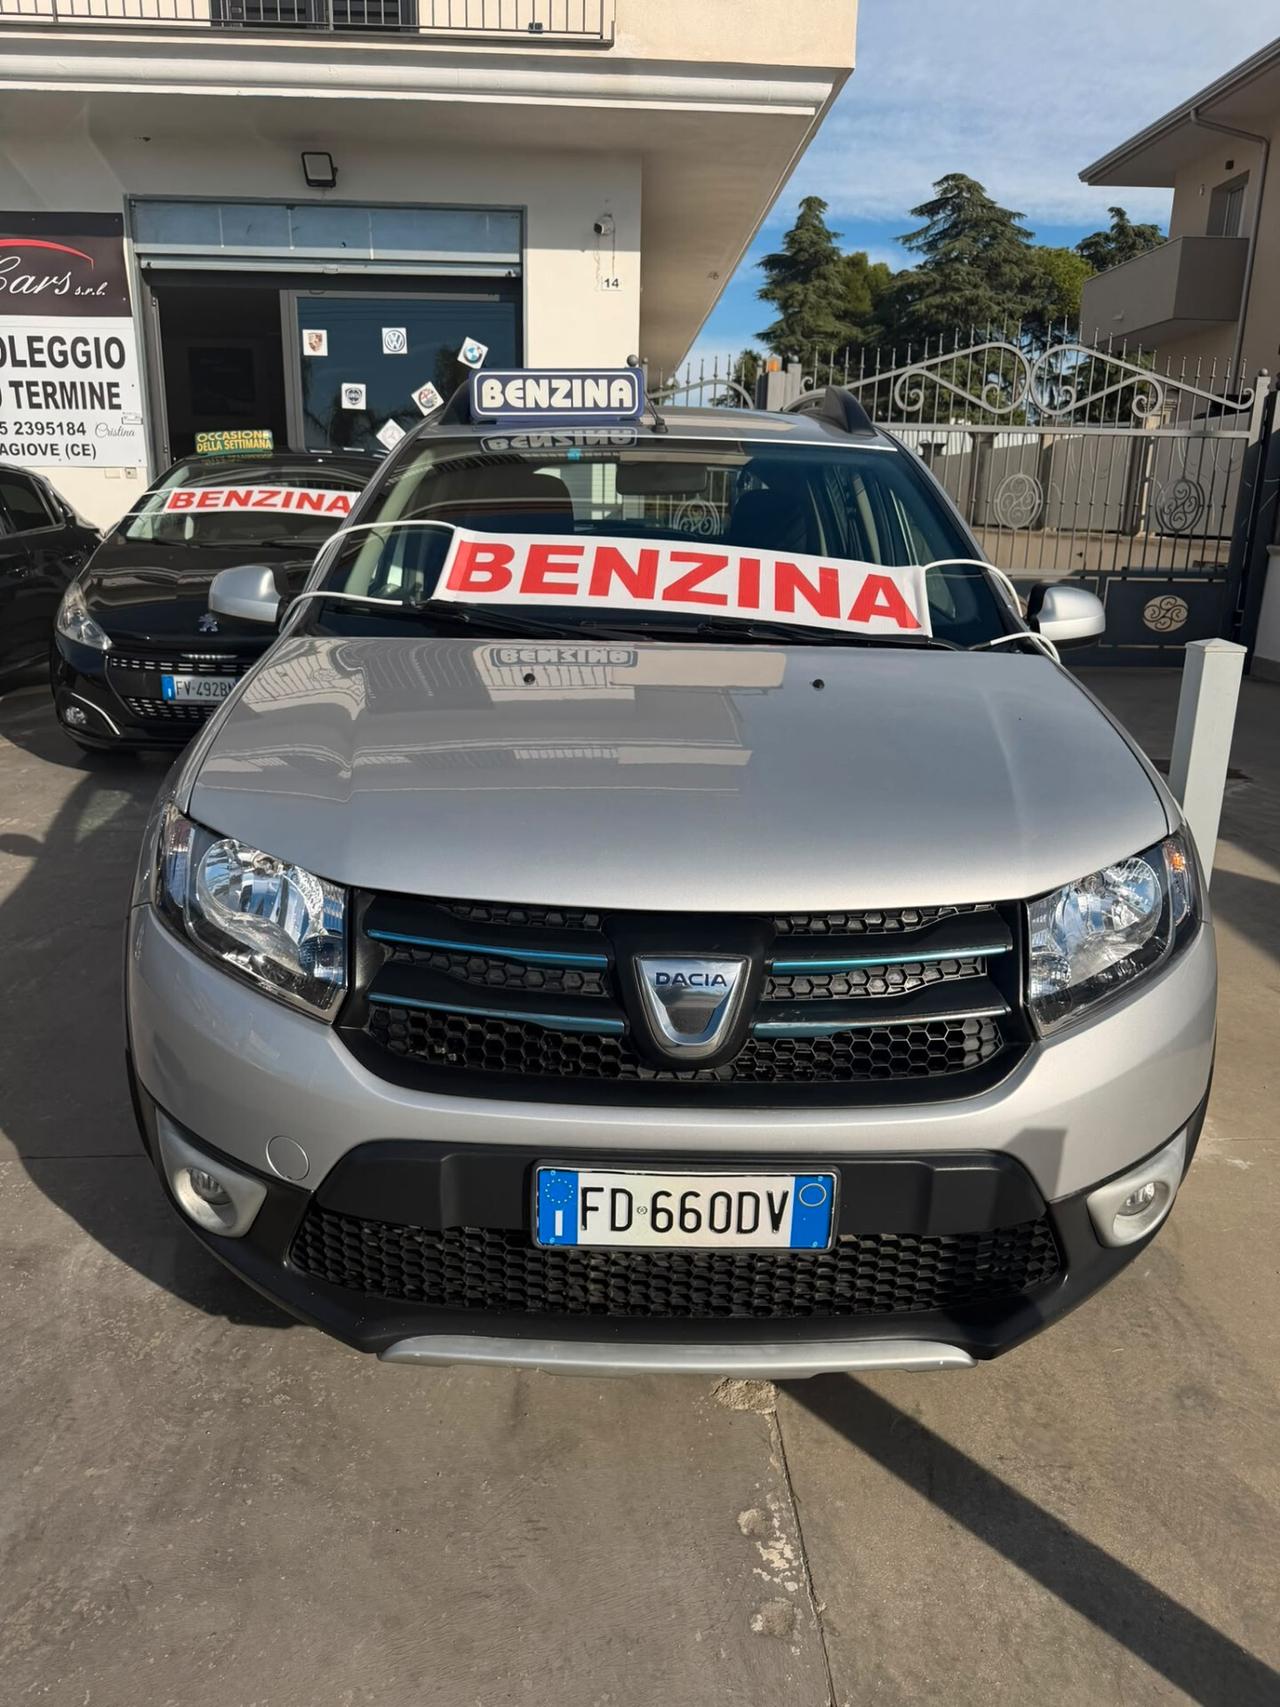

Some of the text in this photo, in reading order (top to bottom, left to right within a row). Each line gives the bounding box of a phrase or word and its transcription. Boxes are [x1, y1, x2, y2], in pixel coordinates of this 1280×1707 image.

[604, 278, 619, 288] 14
[8, 380, 122, 410] TERMINE
[482, 378, 633, 408] BENZINA
[14, 422, 87, 436] 2395184
[95, 422, 135, 438] Cristina
[65, 443, 97, 460] (CE)
[197, 439, 273, 453] DELLA SETTIMANA
[168, 490, 352, 513] BENZINA
[446, 539, 922, 630] BENZINA
[655, 972, 727, 987] DACIA
